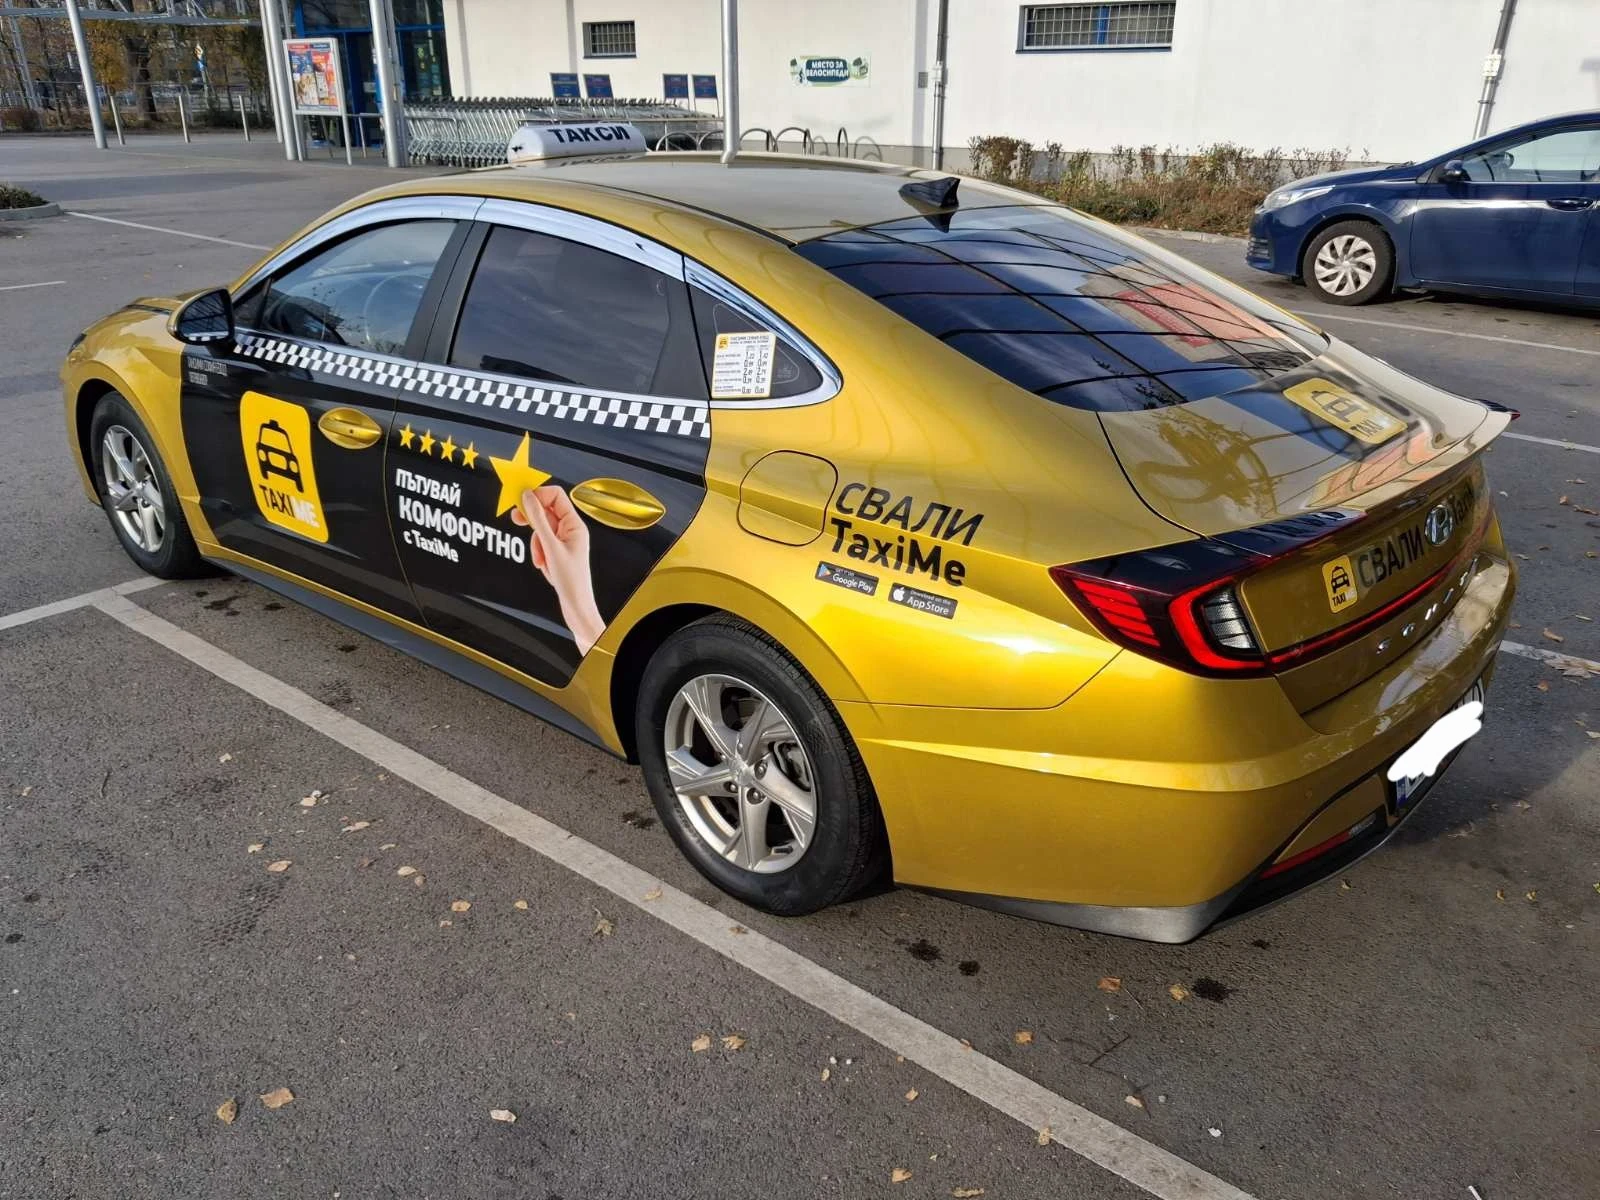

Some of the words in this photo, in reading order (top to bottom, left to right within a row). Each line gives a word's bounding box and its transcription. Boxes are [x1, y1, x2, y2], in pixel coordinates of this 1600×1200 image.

[811, 61, 835, 69] МЯСТО
[835, 61, 844, 69] ЗА
[547, 125, 631, 143] ТАКСИ
[395, 468, 461, 507] ПЪТУВАЙ
[399, 495, 525, 564] КОМФОРТНО
[835, 482, 985, 546] СВАЛИ
[411, 529, 459, 563] TaxiMe
[830, 517, 966, 587] TaxiMe
[1356, 524, 1425, 588] СВАЛИ
[832, 573, 858, 589] Google
[858, 580, 873, 593] Play
[906, 596, 925, 609] App
[925, 600, 950, 615] Store
